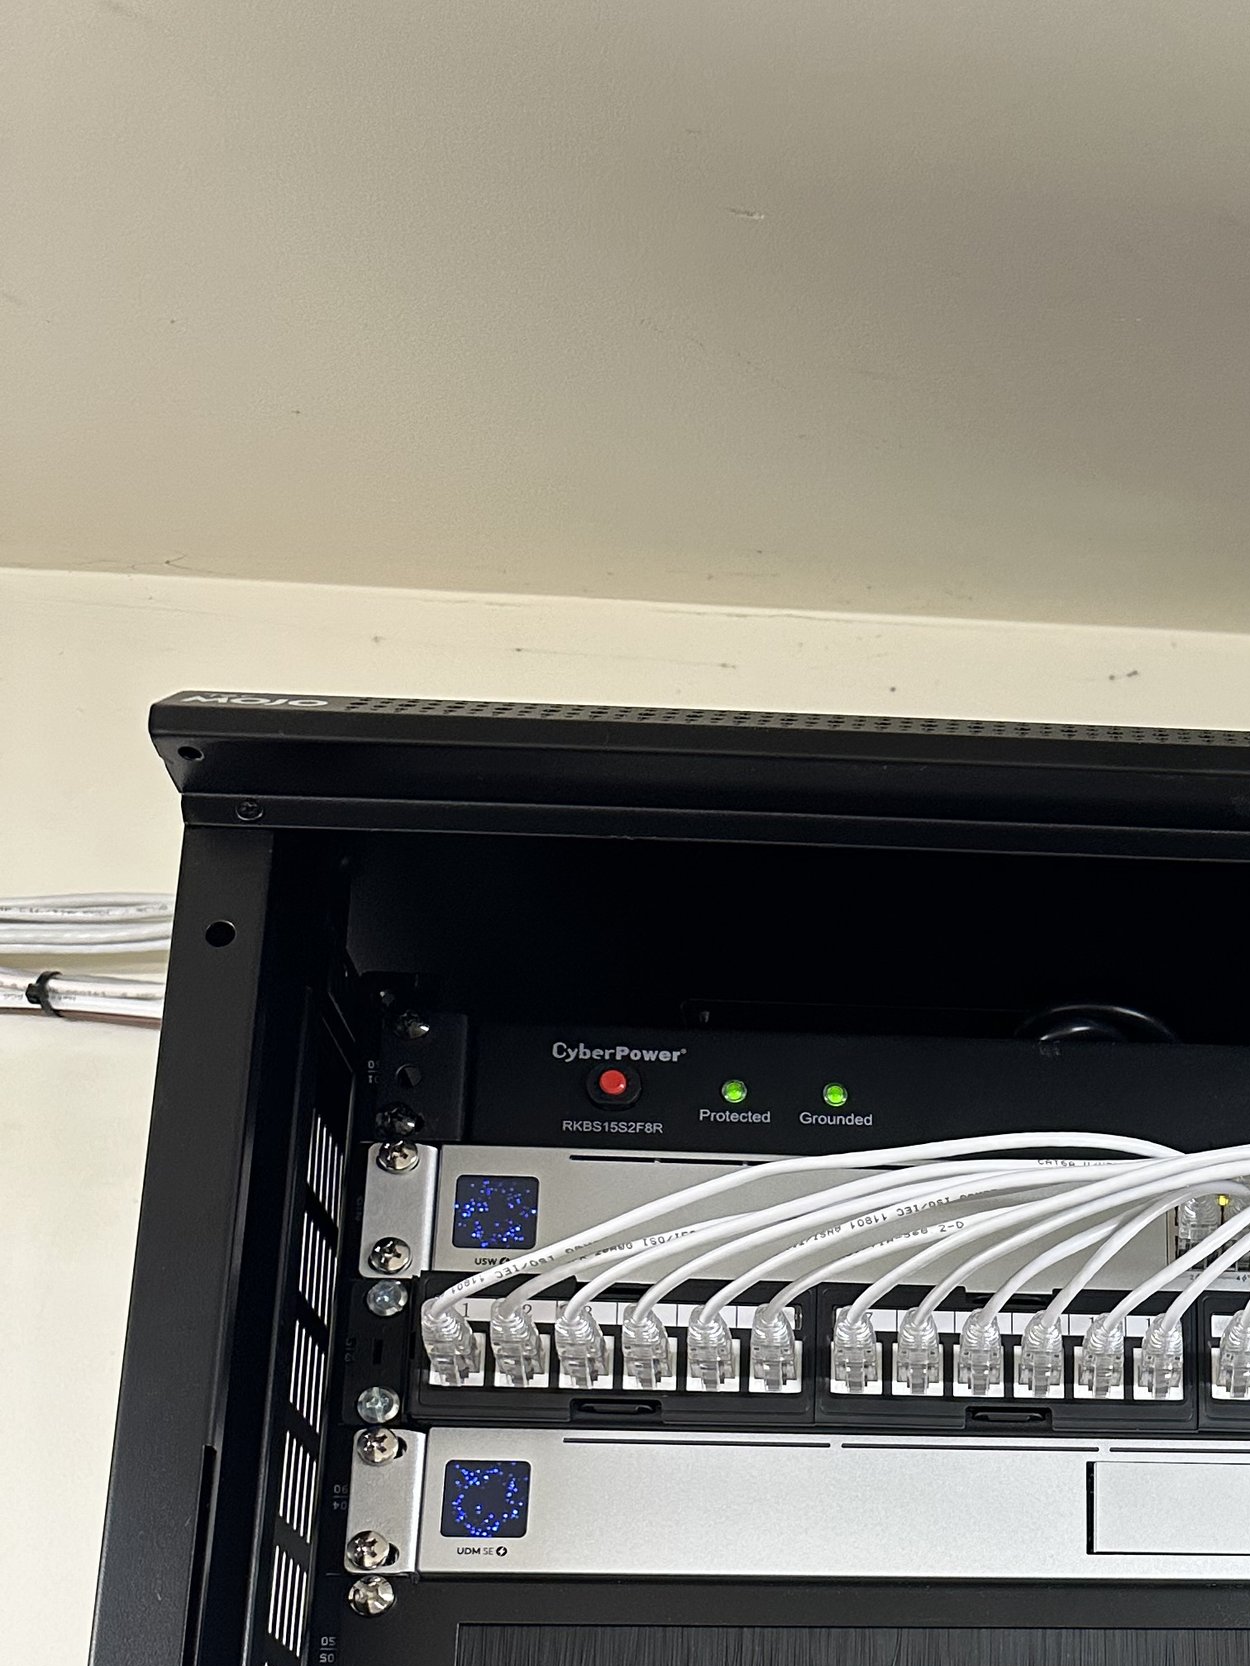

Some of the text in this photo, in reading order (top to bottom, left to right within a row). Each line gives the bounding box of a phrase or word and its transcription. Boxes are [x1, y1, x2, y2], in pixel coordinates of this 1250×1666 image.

[181, 695, 328, 707] MOJO
[551, 1042, 682, 1063] CyberPower
[699, 1109, 771, 1124] Protected
[799, 1112, 873, 1126] Grounded
[561, 1120, 664, 1135] RKBS15S2F8R
[474, 1258, 497, 1266] USW
[457, 1547, 495, 1555] UDM SE
